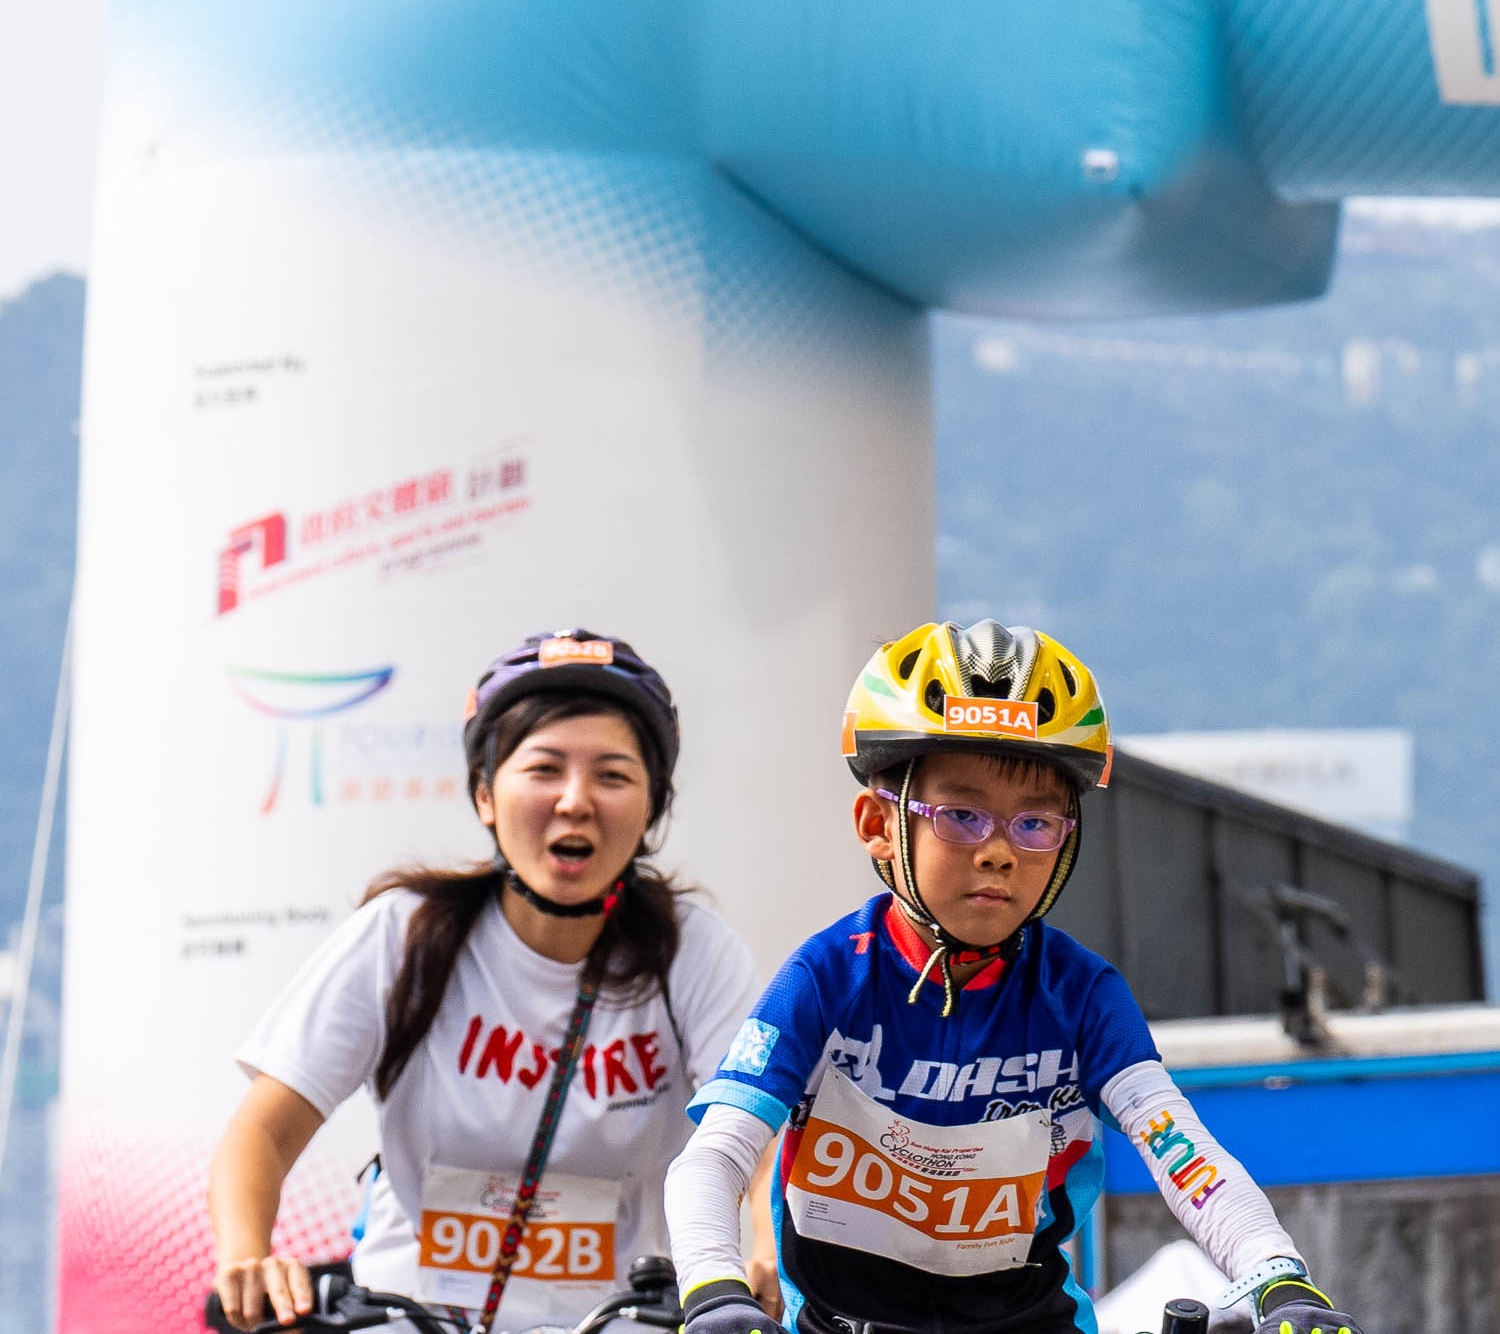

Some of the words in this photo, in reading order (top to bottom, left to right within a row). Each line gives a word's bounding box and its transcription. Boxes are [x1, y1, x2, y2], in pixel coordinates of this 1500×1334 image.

[949, 706, 1032, 731] 9051A
[457, 1014, 666, 1100] INSIRE
[898, 1049, 1079, 1102] DASH
[806, 1132, 1022, 1234] 9051A
[956, 1242, 982, 1250] Family
[984, 1240, 998, 1248] Fun
